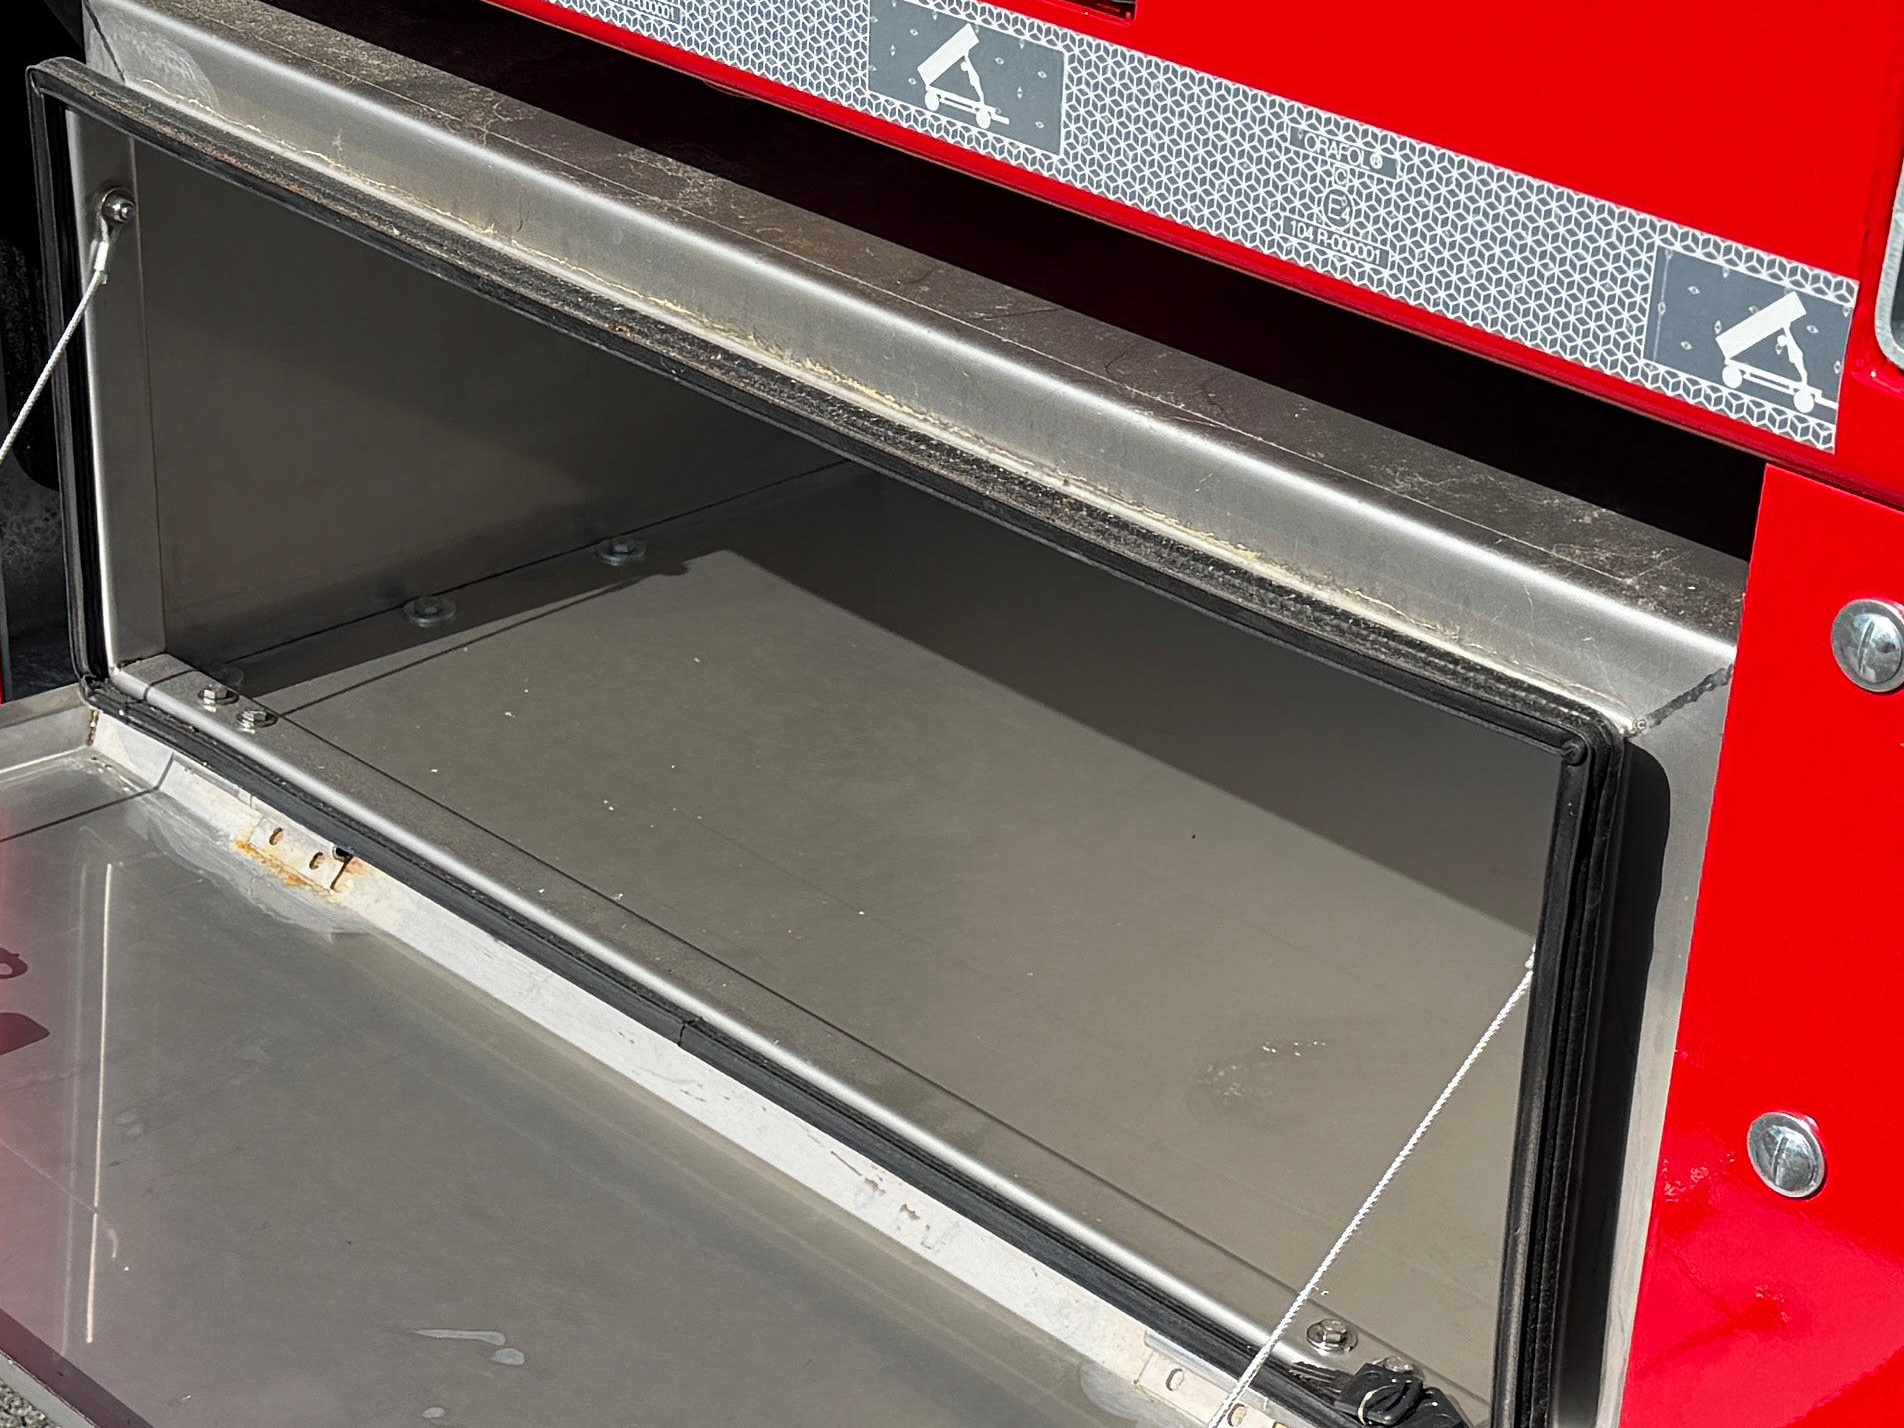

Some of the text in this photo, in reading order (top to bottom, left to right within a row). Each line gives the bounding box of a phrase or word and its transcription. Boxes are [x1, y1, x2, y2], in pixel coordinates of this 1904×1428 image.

[1328, 194, 1351, 223] E4
[1291, 220, 1381, 264] 104 R-000001
